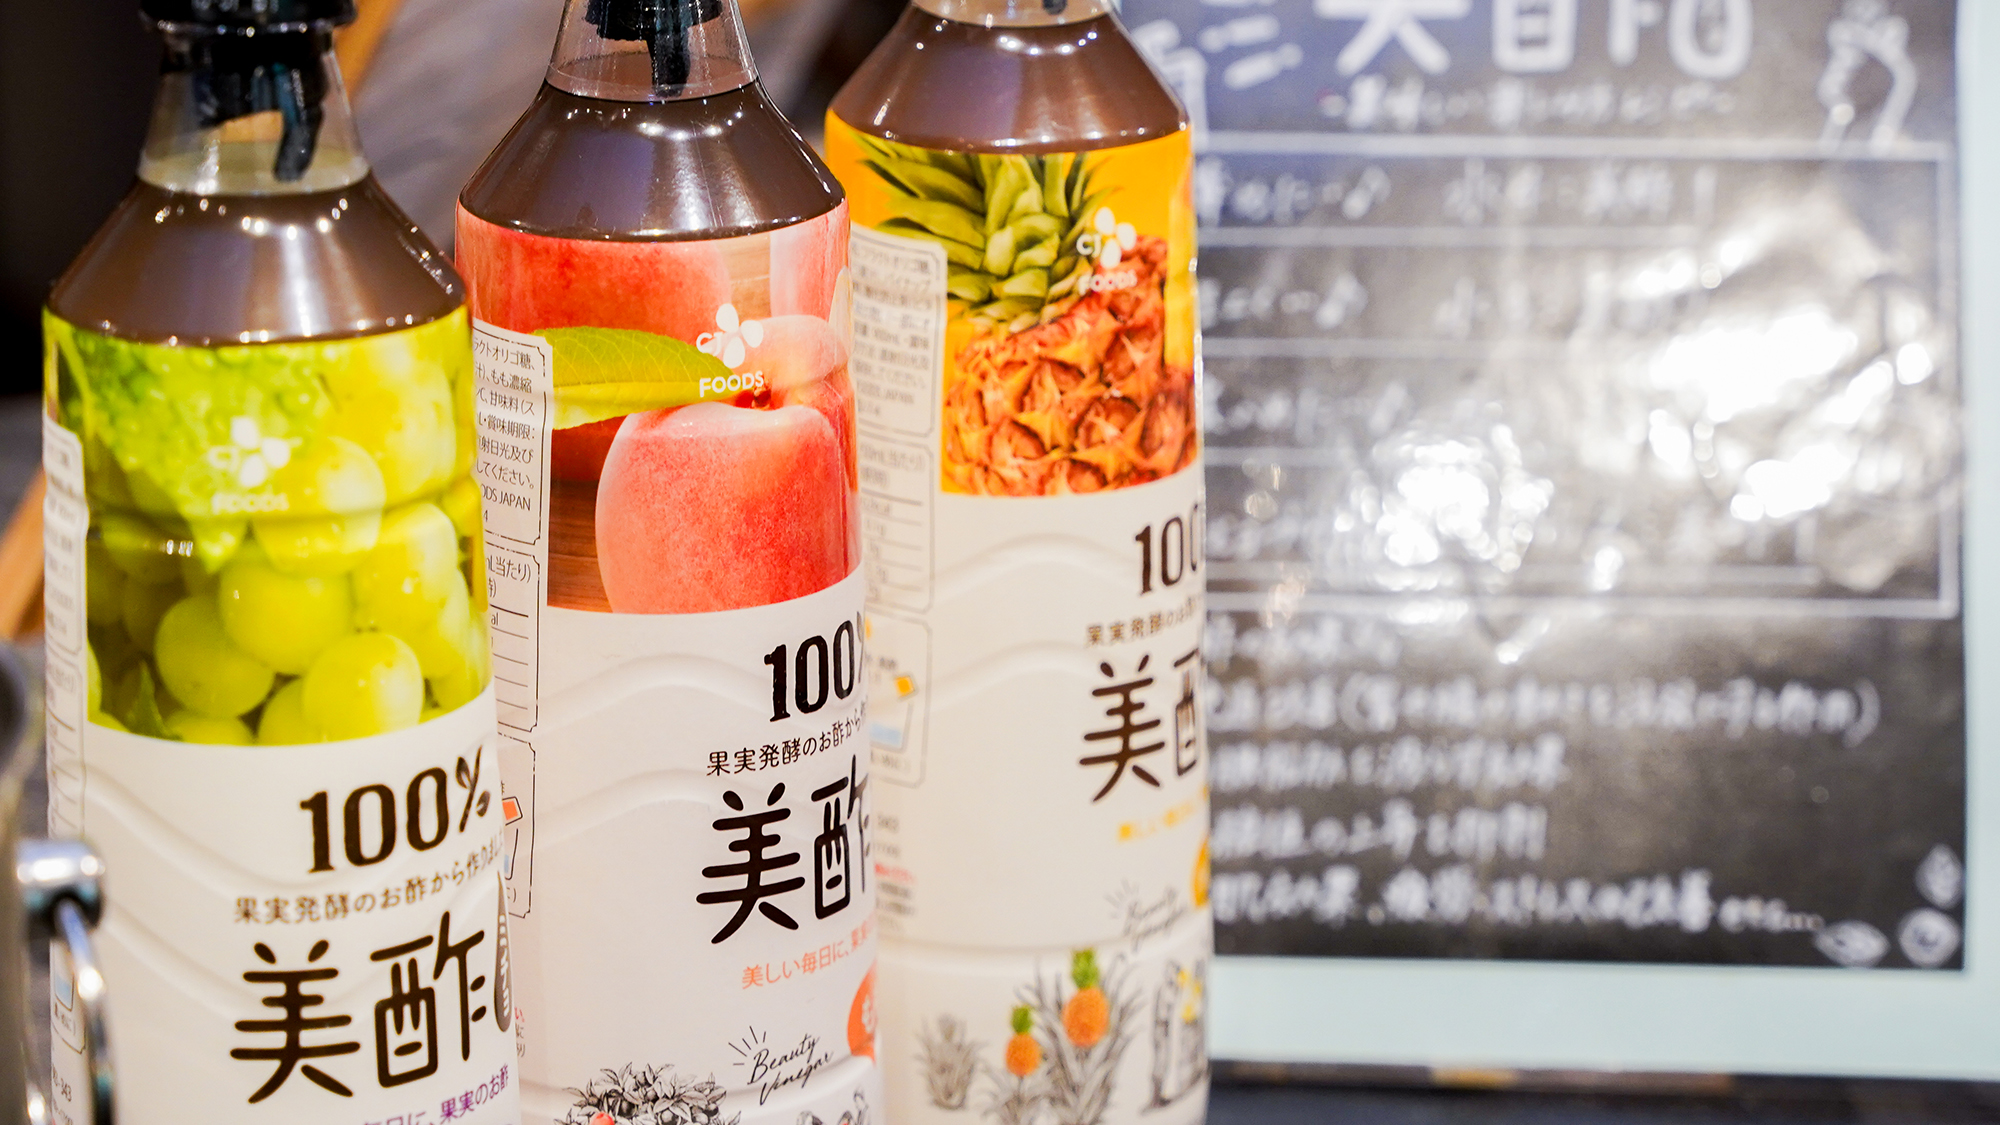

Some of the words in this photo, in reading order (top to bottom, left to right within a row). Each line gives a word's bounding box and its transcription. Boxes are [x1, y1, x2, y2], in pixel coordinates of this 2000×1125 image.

[1078, 270, 1138, 296] FOODS
[696, 330, 723, 355] CJ
[699, 371, 764, 397] FOODS
[499, 490, 531, 512] JAPAN
[299, 744, 491, 874] 100%
[229, 910, 487, 1105] 美酢
[747, 1033, 820, 1085] Beauty
[759, 1051, 834, 1106] Vinegar
